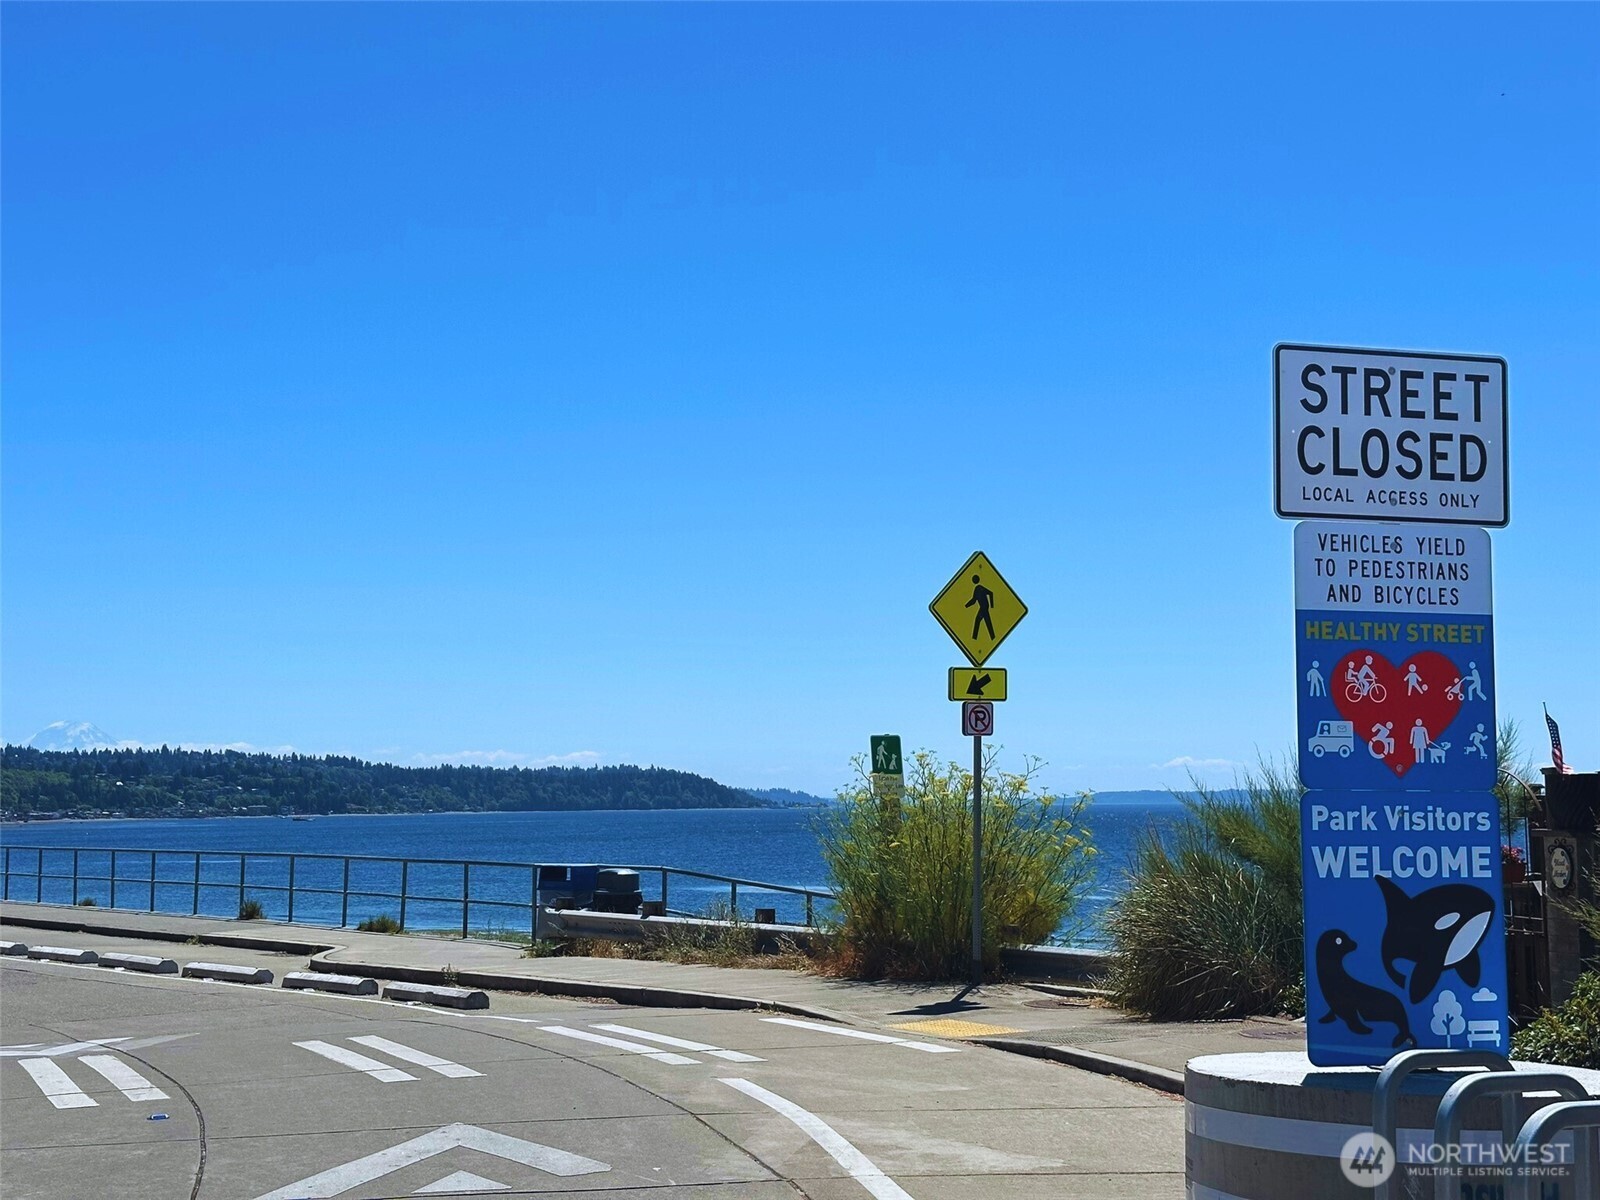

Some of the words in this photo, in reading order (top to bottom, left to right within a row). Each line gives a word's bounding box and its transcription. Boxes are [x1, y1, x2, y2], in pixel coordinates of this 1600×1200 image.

[1300, 363, 1490, 423] STREET
[1297, 425, 1488, 483] CLOSED
[1302, 486, 1354, 502] LOCAL
[1366, 489, 1428, 506] ACCESS
[1439, 493, 1480, 508] ONLY
[1318, 533, 1403, 554] VEHICLES
[1416, 537, 1466, 556] YIELD
[1315, 558, 1336, 577] TO
[1349, 560, 1469, 581] PEDESTRIANS
[1327, 584, 1361, 603] AND
[1375, 586, 1459, 606] BICYCLES
[1305, 620, 1401, 641] HEALTHY
[1406, 623, 1486, 644] STREET
[1311, 805, 1378, 831] Park
[1384, 805, 1491, 831] Visitors
[1311, 846, 1492, 878] WELCOME
